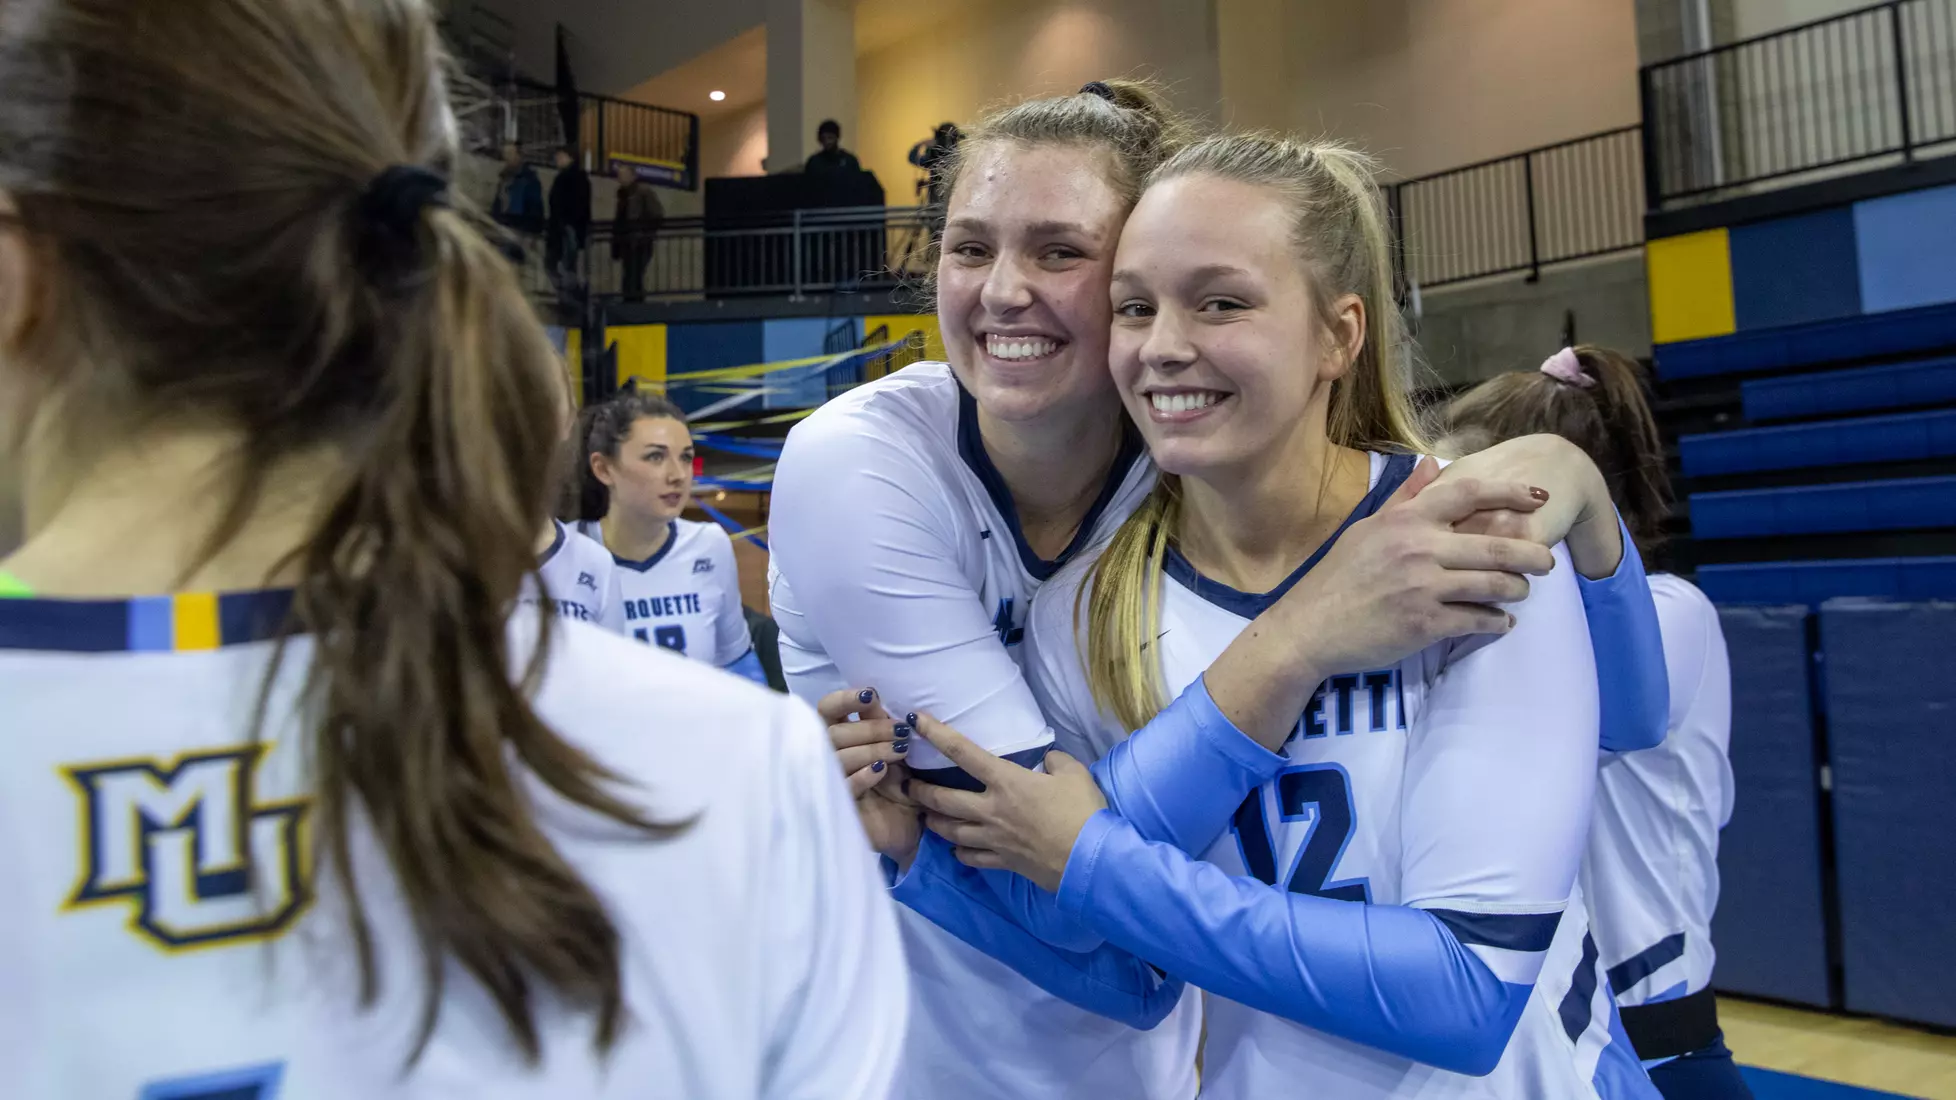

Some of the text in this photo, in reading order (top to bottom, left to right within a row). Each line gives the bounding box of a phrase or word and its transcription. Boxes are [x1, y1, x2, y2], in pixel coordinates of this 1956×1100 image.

[623, 594, 700, 620] RQUETTE
[1287, 669, 1406, 742] ETT
[56, 741, 316, 956] MU
[1229, 762, 1373, 905] 12
